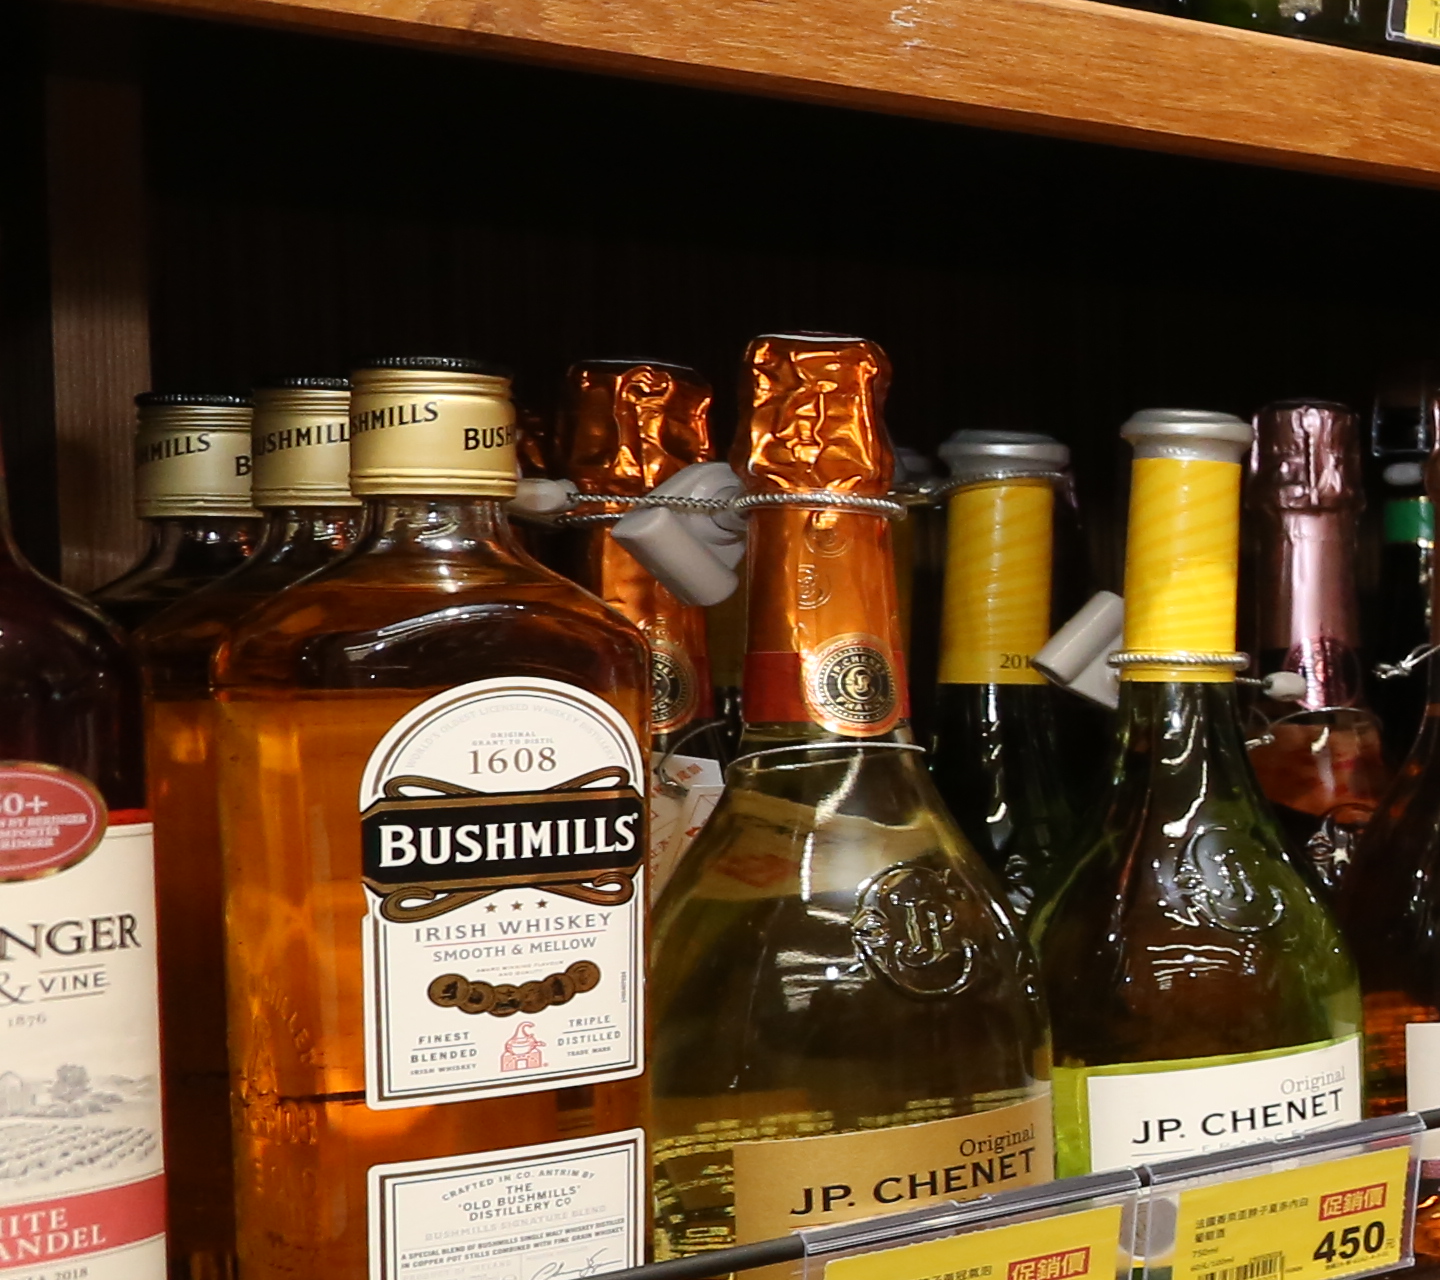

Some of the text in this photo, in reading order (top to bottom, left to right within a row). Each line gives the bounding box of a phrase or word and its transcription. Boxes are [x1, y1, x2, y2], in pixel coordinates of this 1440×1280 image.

[468, 746, 557, 775] 1608
[379, 814, 636, 867] BUSHMILLS
[415, 912, 613, 943] IRISH WHISKEY
[433, 936, 597, 963] SMOOTH & MELLOW
[38, 970, 109, 993] VINE
[569, 1014, 611, 1028] TRIPLE
[418, 1031, 470, 1045] FINEST
[557, 1030, 621, 1046] DISTILLED
[410, 1048, 477, 1063] BLENDED
[1280, 1065, 1345, 1097] Original
[1132, 1089, 1344, 1146] JP. CHENET
[959, 1123, 1036, 1160] Original
[441, 1168, 579, 1201] CRAFTED ANTRIM
[505, 1183, 533, 1194] THE
[790, 1150, 1036, 1216] JP. CHENET
[469, 1201, 550, 1221] DISTILLERY
[1322, 1186, 1385, 1218] 促銷價
[1313, 1221, 1385, 1262] 450
